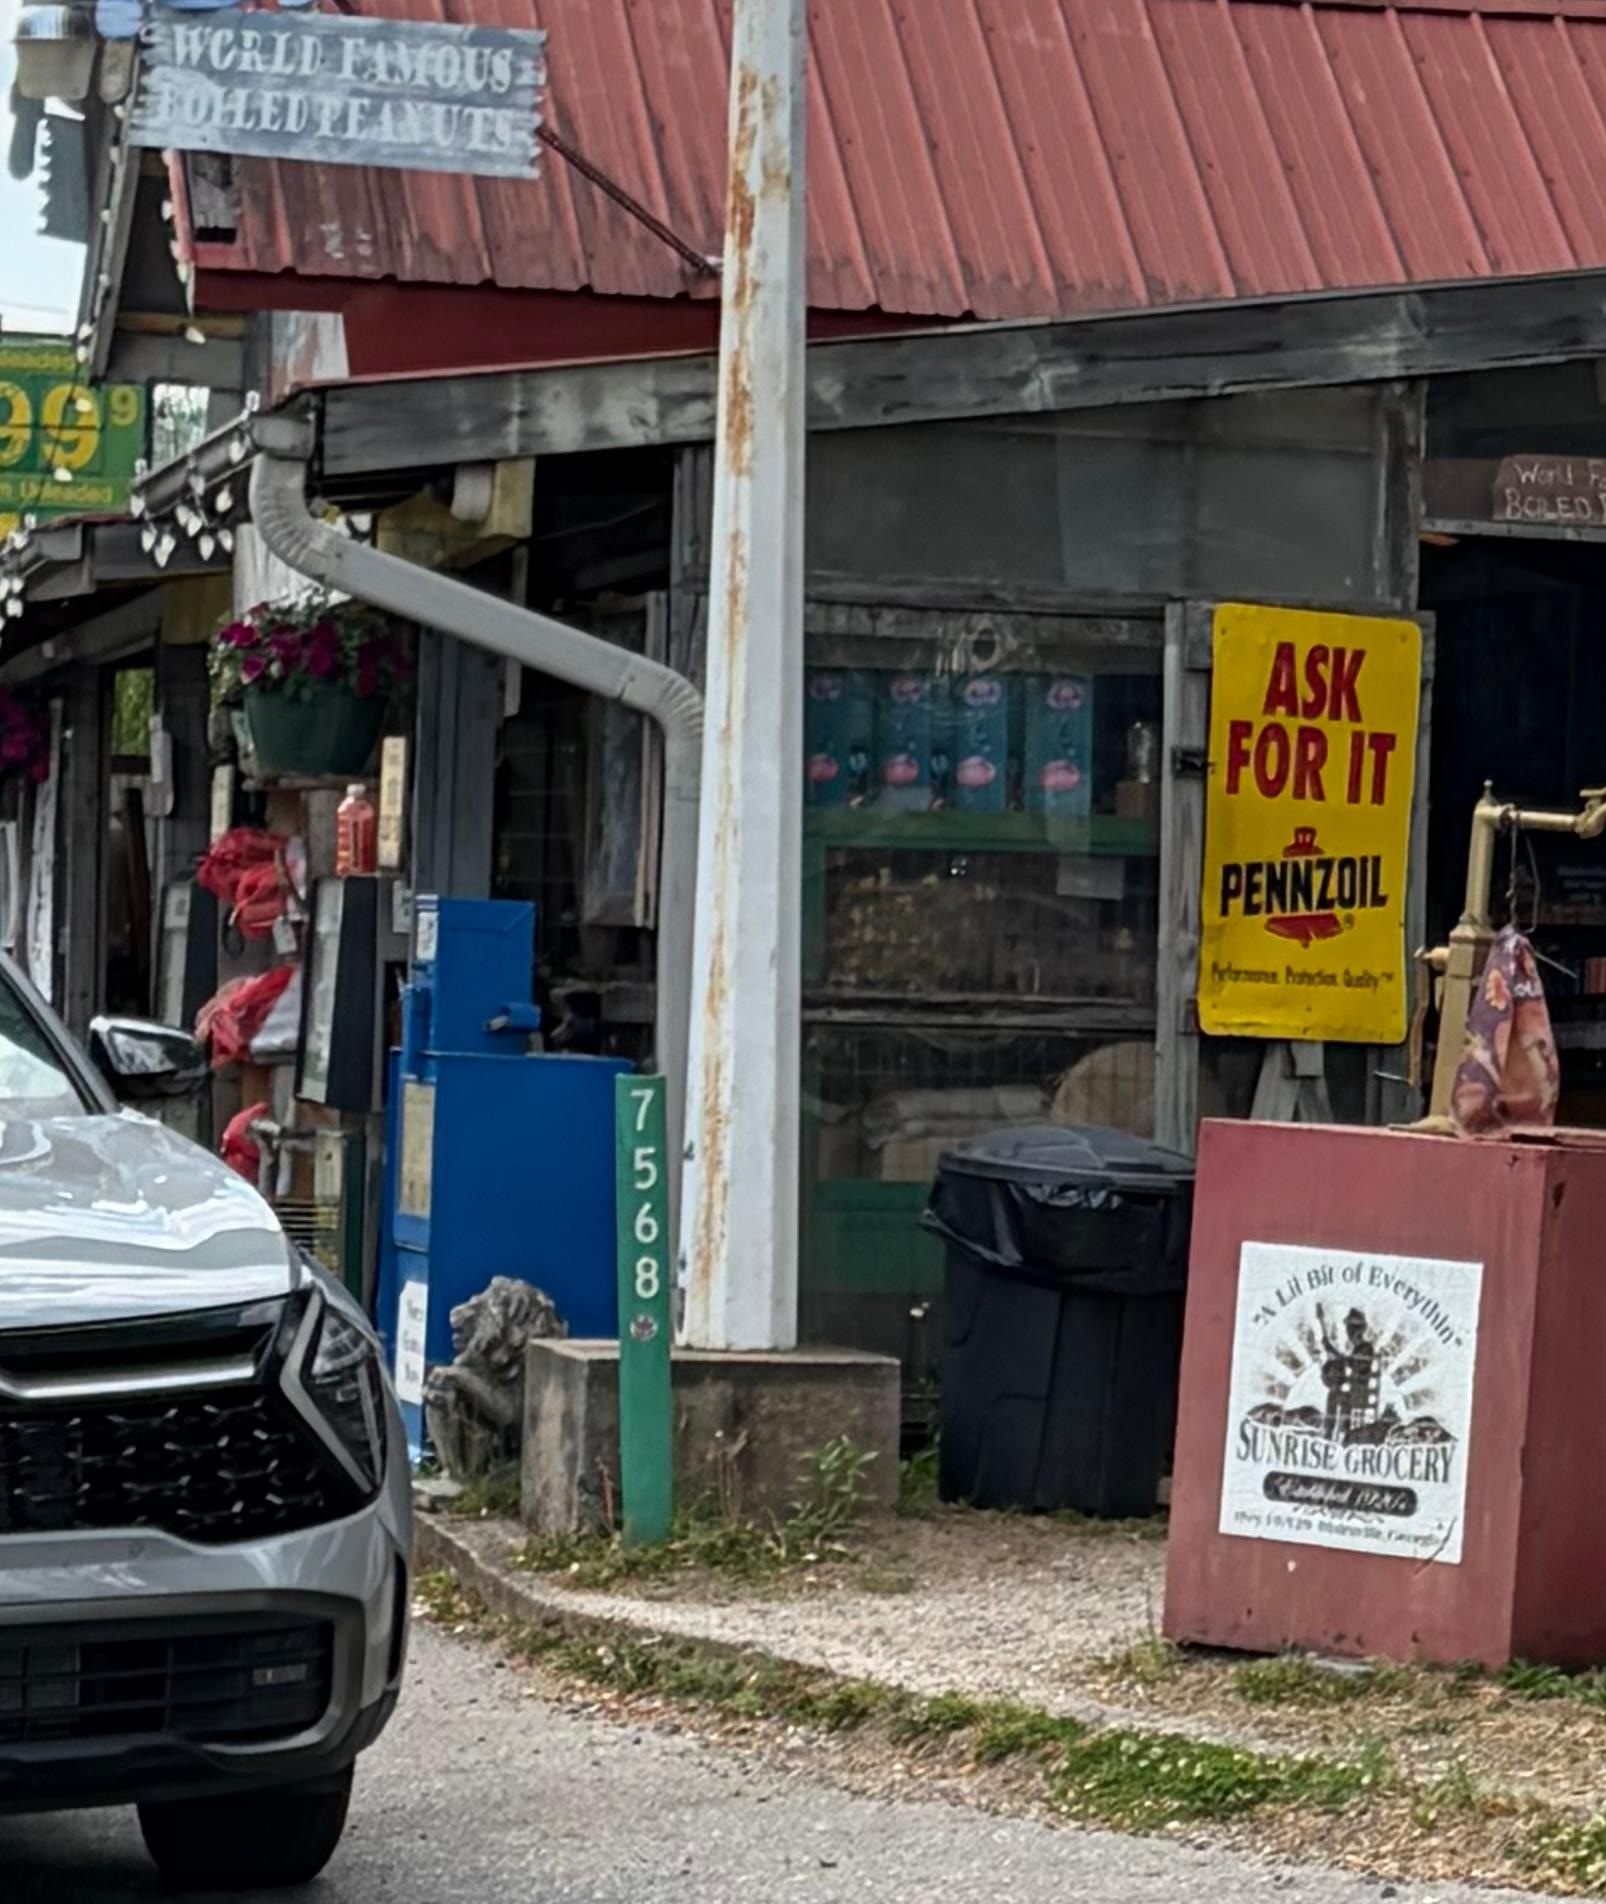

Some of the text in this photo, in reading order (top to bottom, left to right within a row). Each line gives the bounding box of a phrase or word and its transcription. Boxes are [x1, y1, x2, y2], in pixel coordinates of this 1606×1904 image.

[173, 24, 514, 94] WORLD FAMOUS
[157, 87, 514, 153] BOILED PEANUTS
[1262, 641, 1367, 723] ASK
[1225, 719, 1397, 806] FOR IT
[1219, 855, 1389, 918] PENNZOIL
[1275, 1275, 1304, 1307] Lil
[1306, 1264, 1335, 1290] Bit
[1341, 1260, 1364, 1284] of
[1236, 1418, 1458, 1484] SUNRISE GROCERY
